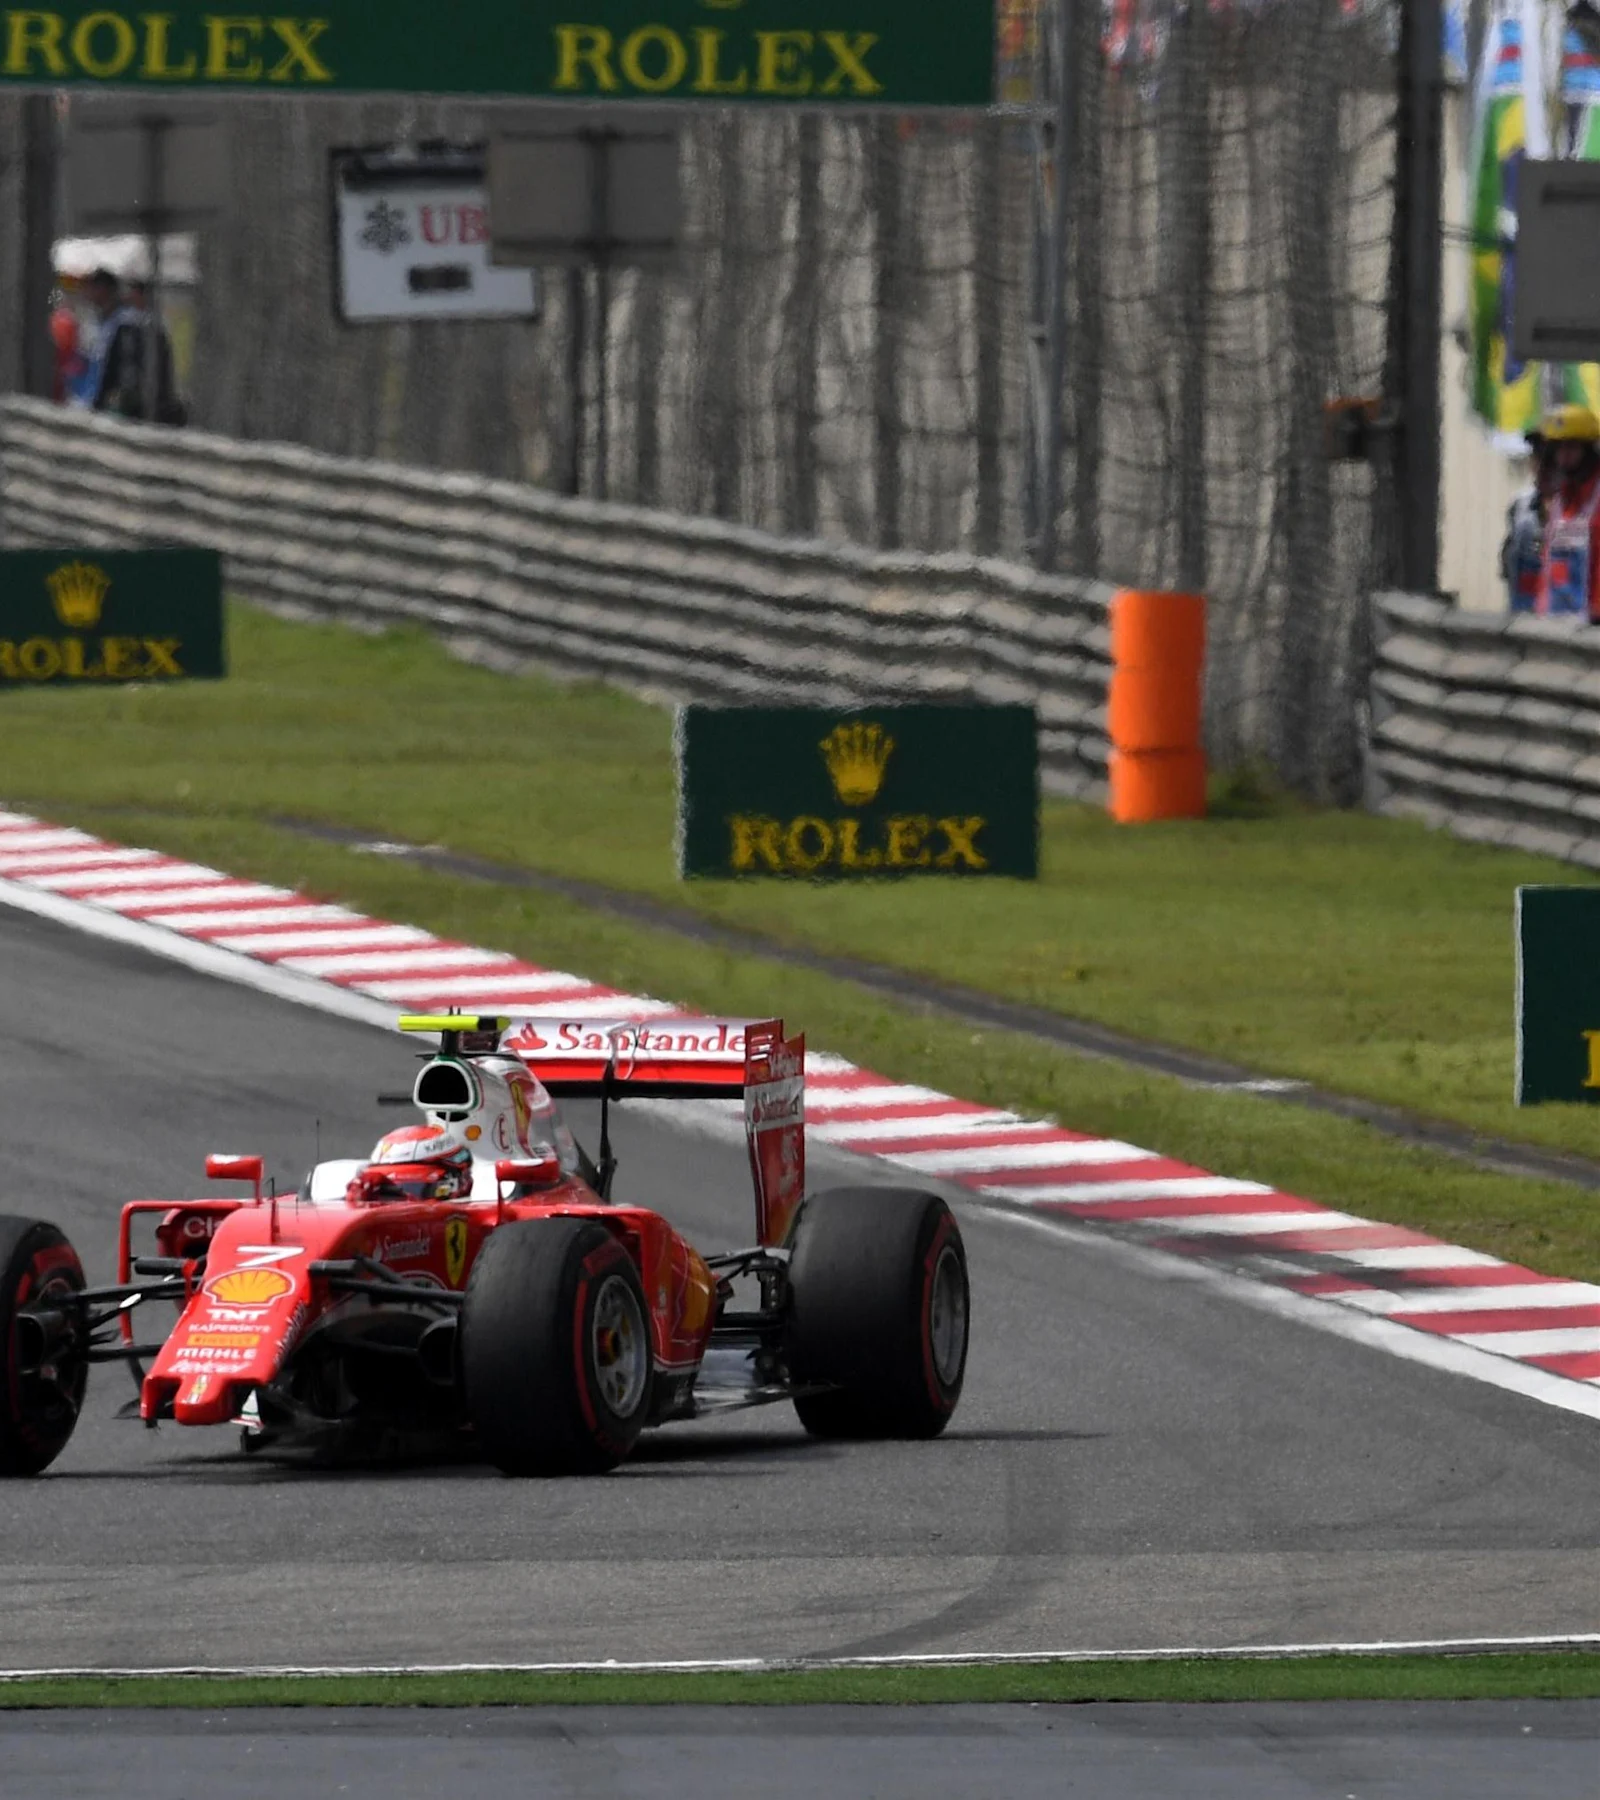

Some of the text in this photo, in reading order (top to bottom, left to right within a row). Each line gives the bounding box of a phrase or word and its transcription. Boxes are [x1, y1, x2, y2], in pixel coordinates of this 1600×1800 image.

[1, 11, 885, 94] ROLEX ROLEX
[420, 203, 491, 246] UB
[727, 813, 988, 871] ROLEX
[555, 1022, 746, 1052] Santande
[236, 1245, 305, 1267] 7
[206, 1308, 269, 1321] TNT
[176, 1347, 257, 1360] MAHLE
